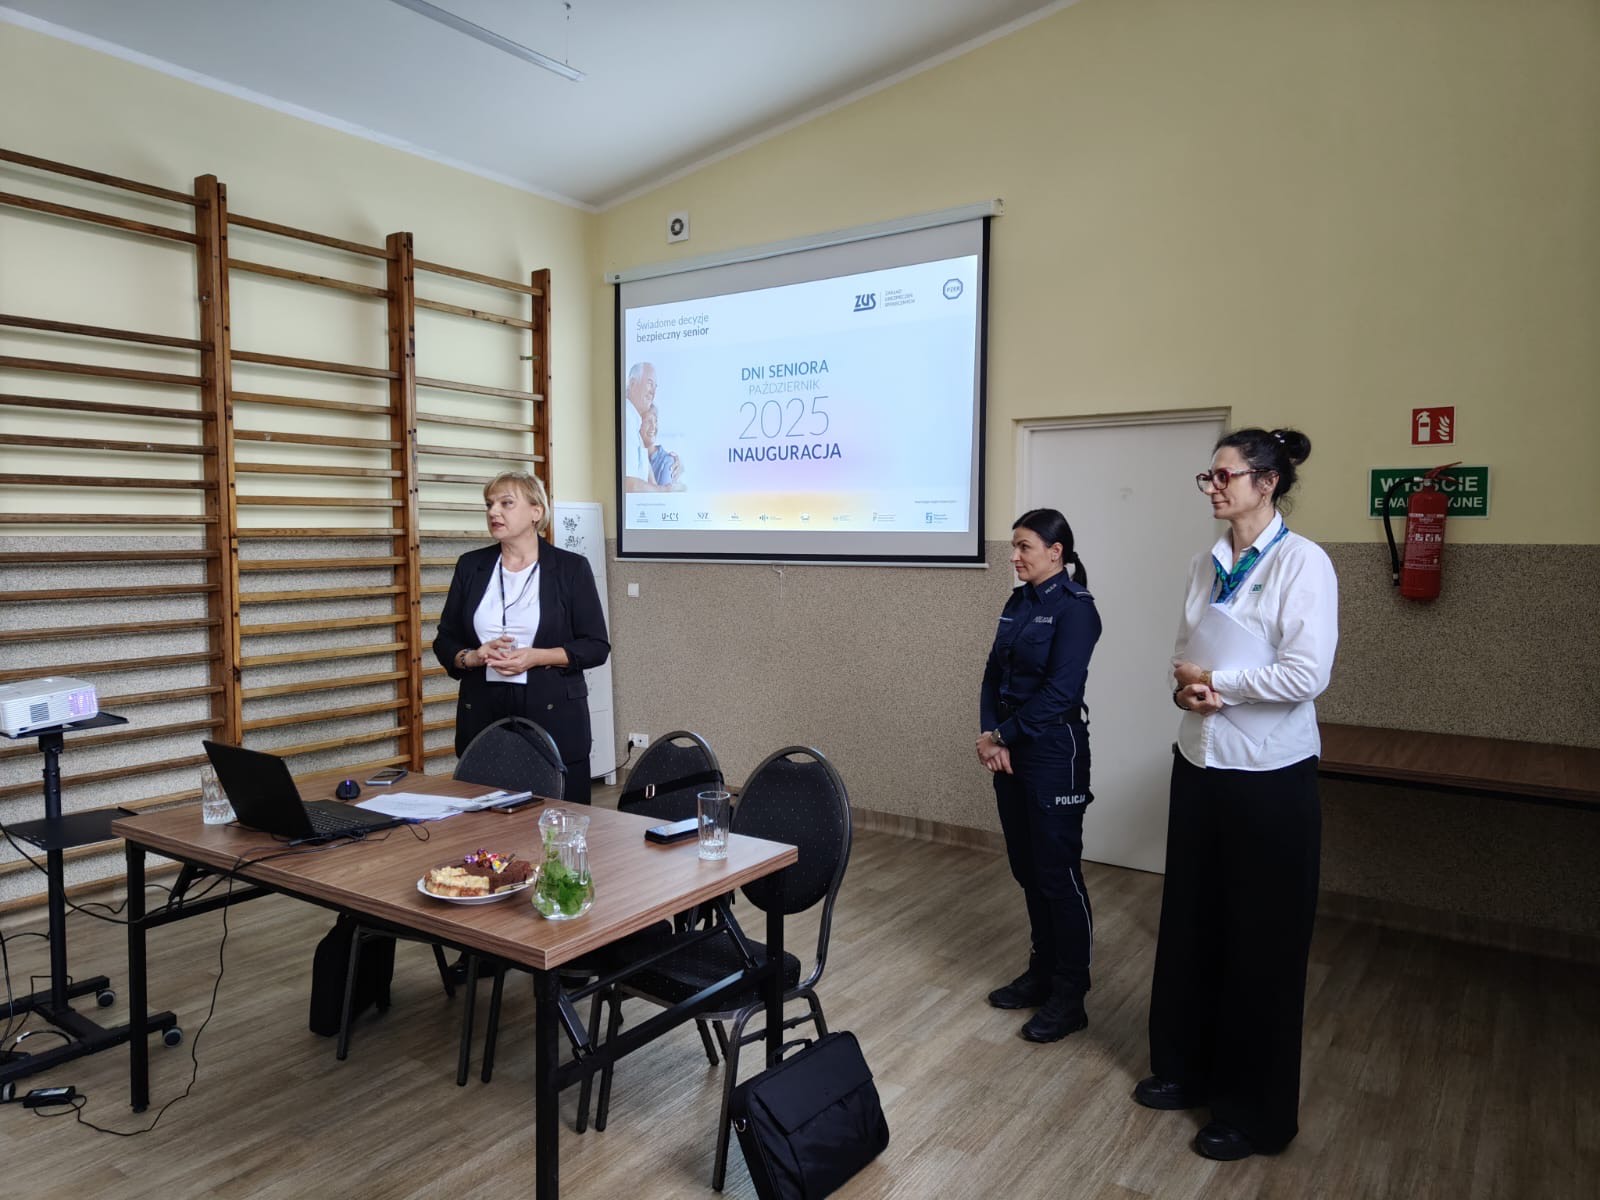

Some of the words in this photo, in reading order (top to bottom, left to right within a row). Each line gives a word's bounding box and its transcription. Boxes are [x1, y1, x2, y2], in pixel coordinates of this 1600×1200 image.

[853, 293, 876, 312] ZUS
[636, 316, 677, 331] Świadome
[678, 312, 709, 327] decyzje
[636, 328, 680, 343] bezpieczny
[683, 325, 709, 338] senior
[741, 364, 765, 381] DNI
[768, 359, 829, 378] SENIORA
[748, 377, 820, 396] PAŹDZIERNIK
[739, 395, 829, 440] 2025
[728, 443, 842, 463] INAUGURACJA
